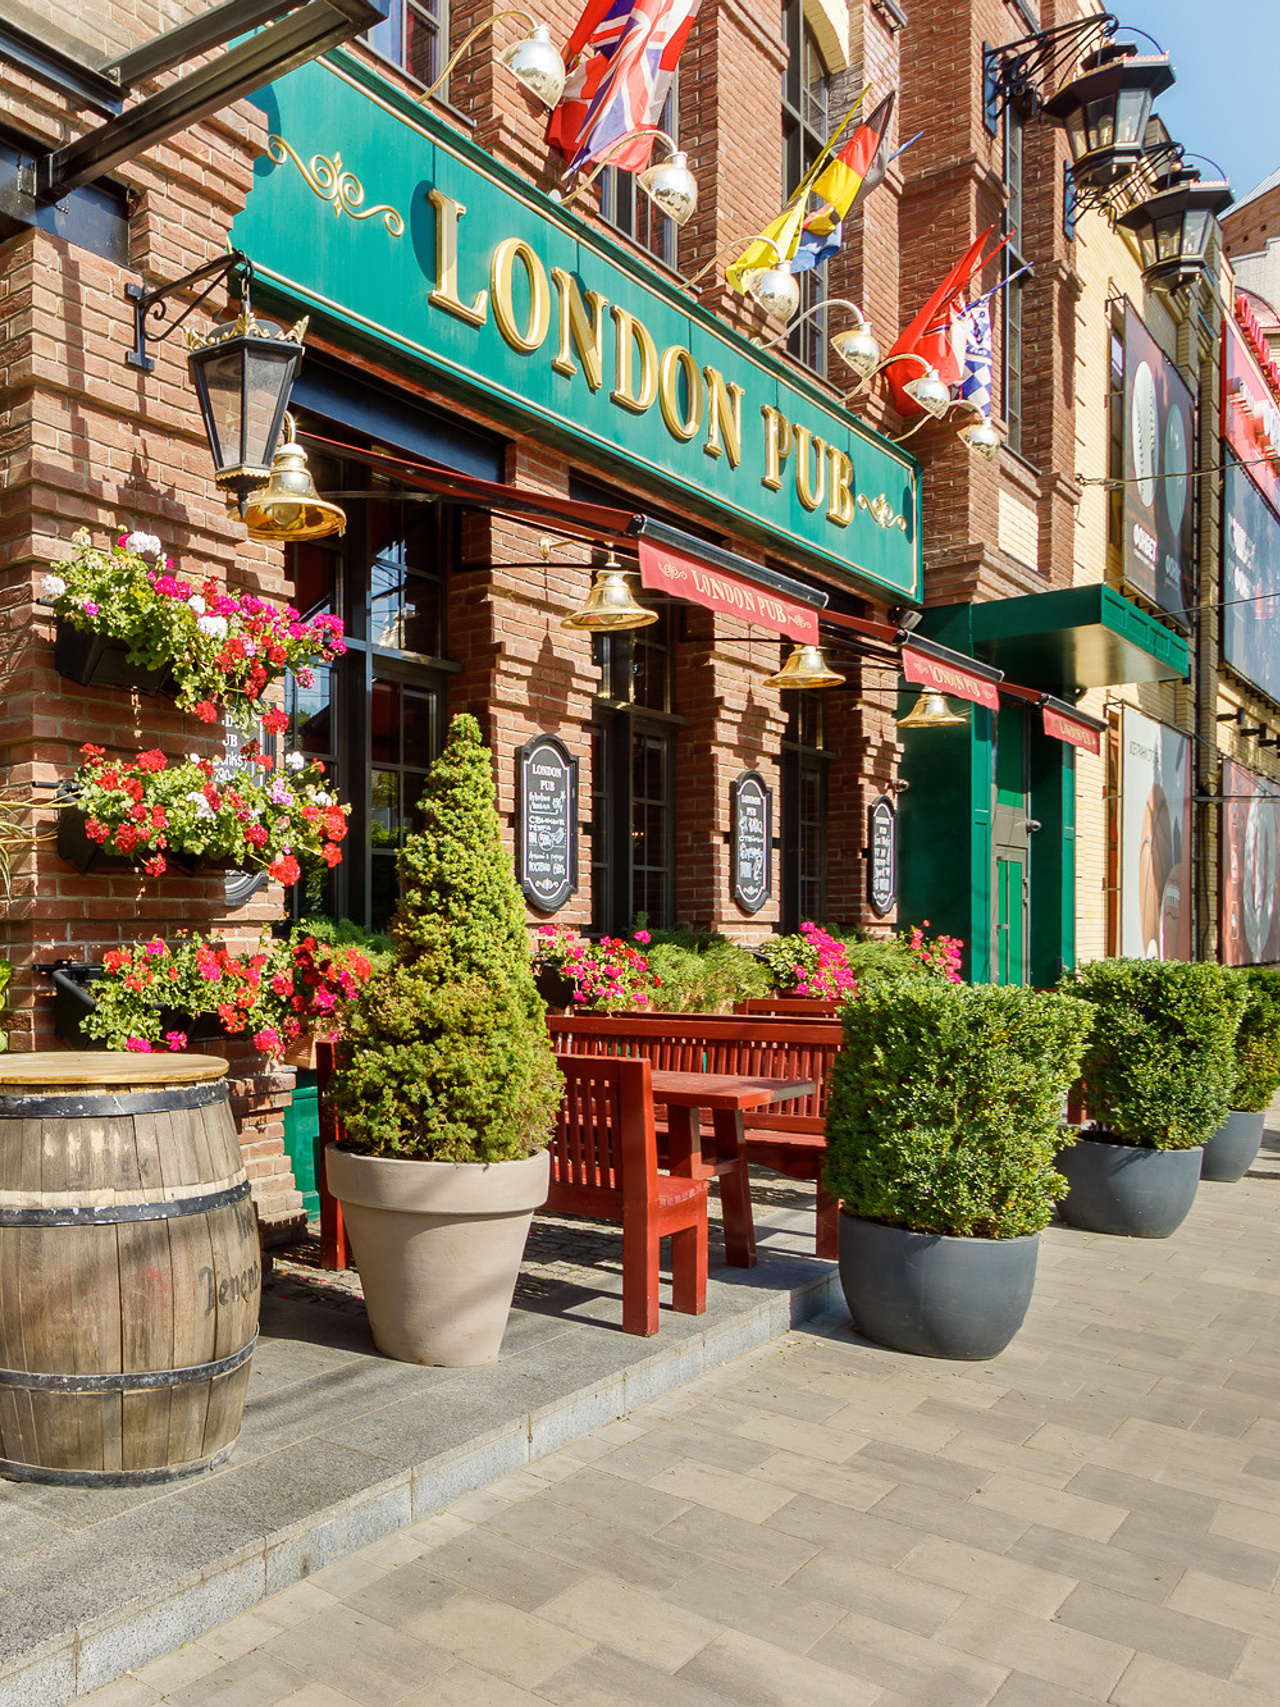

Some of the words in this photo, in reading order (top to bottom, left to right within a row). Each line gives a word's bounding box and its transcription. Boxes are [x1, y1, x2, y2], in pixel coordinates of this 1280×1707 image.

[427, 188, 745, 468] LONDON
[760, 404, 856, 527] PUB
[691, 569, 756, 612] LONDON
[757, 595, 788, 624] PUB
[222, 733, 238, 747] UB
[532, 764, 562, 778] LONDON
[540, 780, 555, 792] PUB
